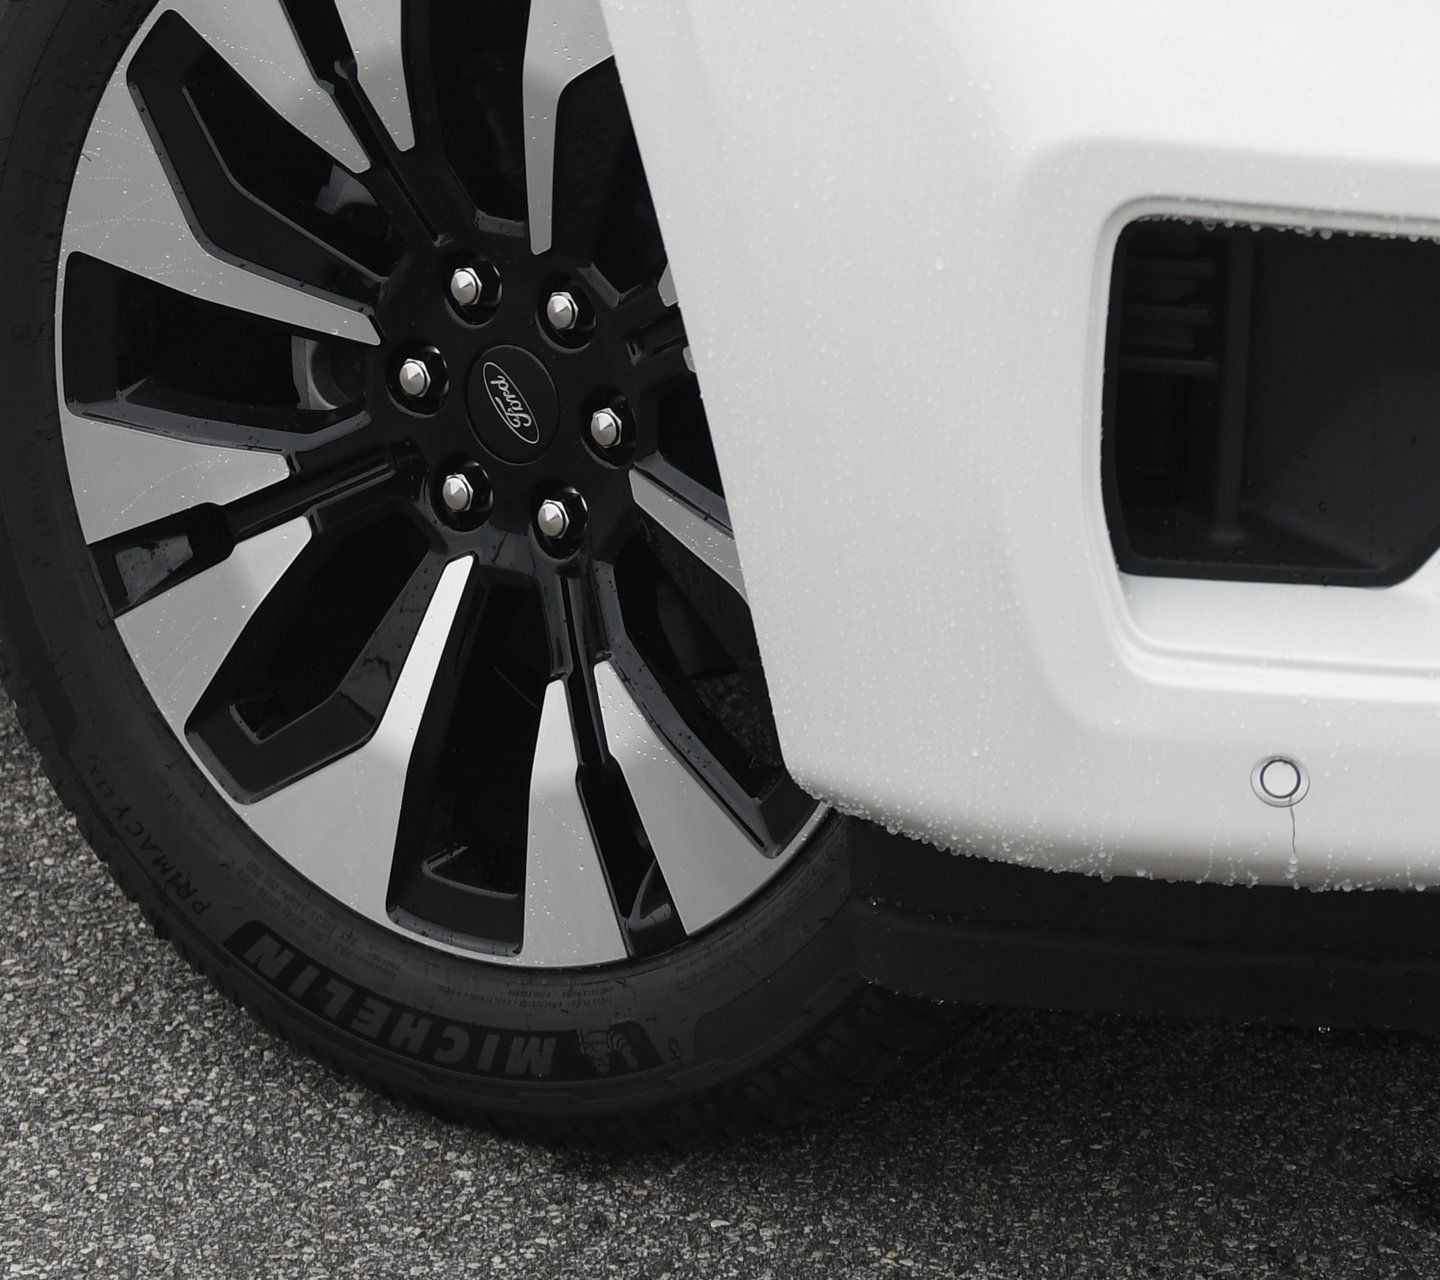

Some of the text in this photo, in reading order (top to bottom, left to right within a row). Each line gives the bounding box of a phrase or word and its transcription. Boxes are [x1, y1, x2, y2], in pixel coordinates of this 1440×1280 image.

[490, 375, 532, 428] Ford
[112, 805, 212, 915] PRIMACY
[242, 933, 557, 1077] MICHELIN
